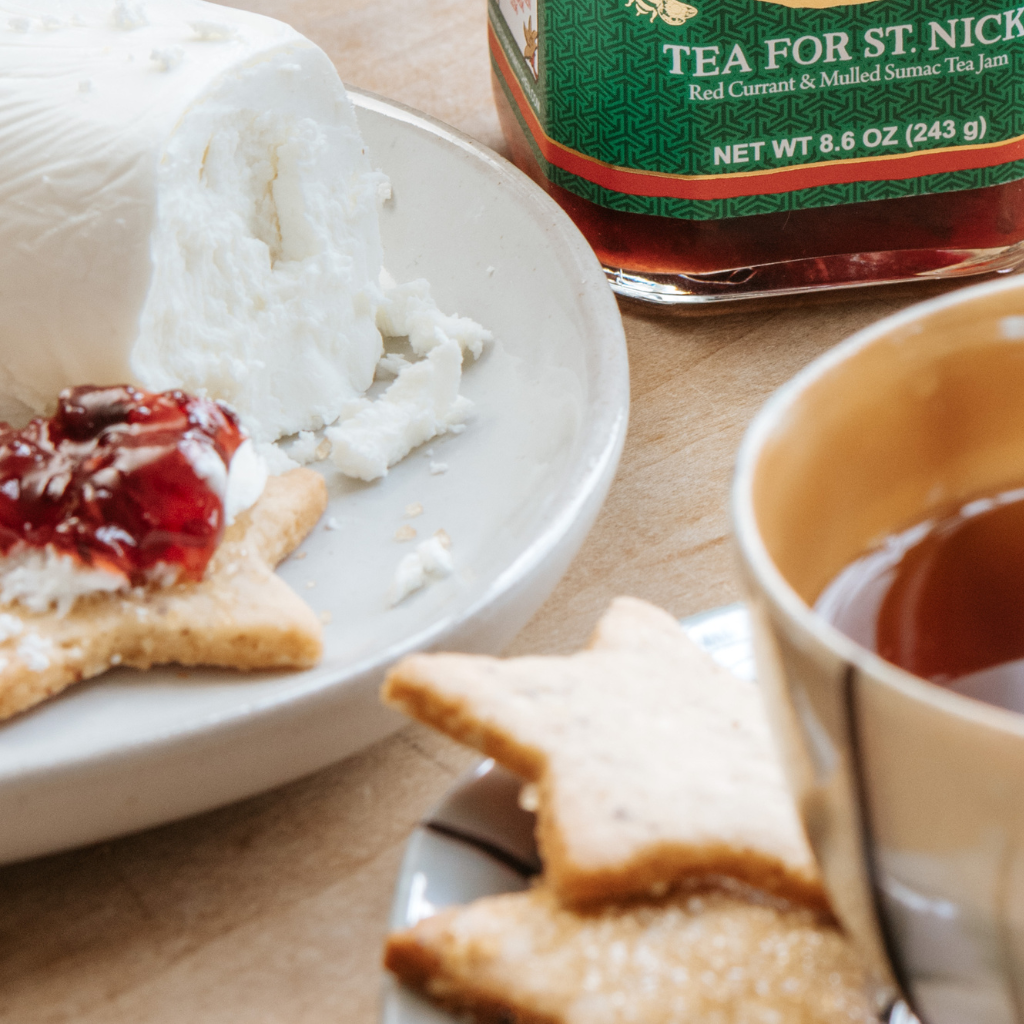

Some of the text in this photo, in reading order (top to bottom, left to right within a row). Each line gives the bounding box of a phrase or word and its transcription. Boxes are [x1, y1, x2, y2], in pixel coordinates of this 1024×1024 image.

[663, 43, 752, 78] TEA
[764, 34, 852, 70] FOR
[863, 25, 917, 58] ST.
[688, 51, 1009, 101] Red Currant & Mulled Sumac Tea Jam
[713, 116, 987, 166] NET WT 8.6 OZ (243 g)
